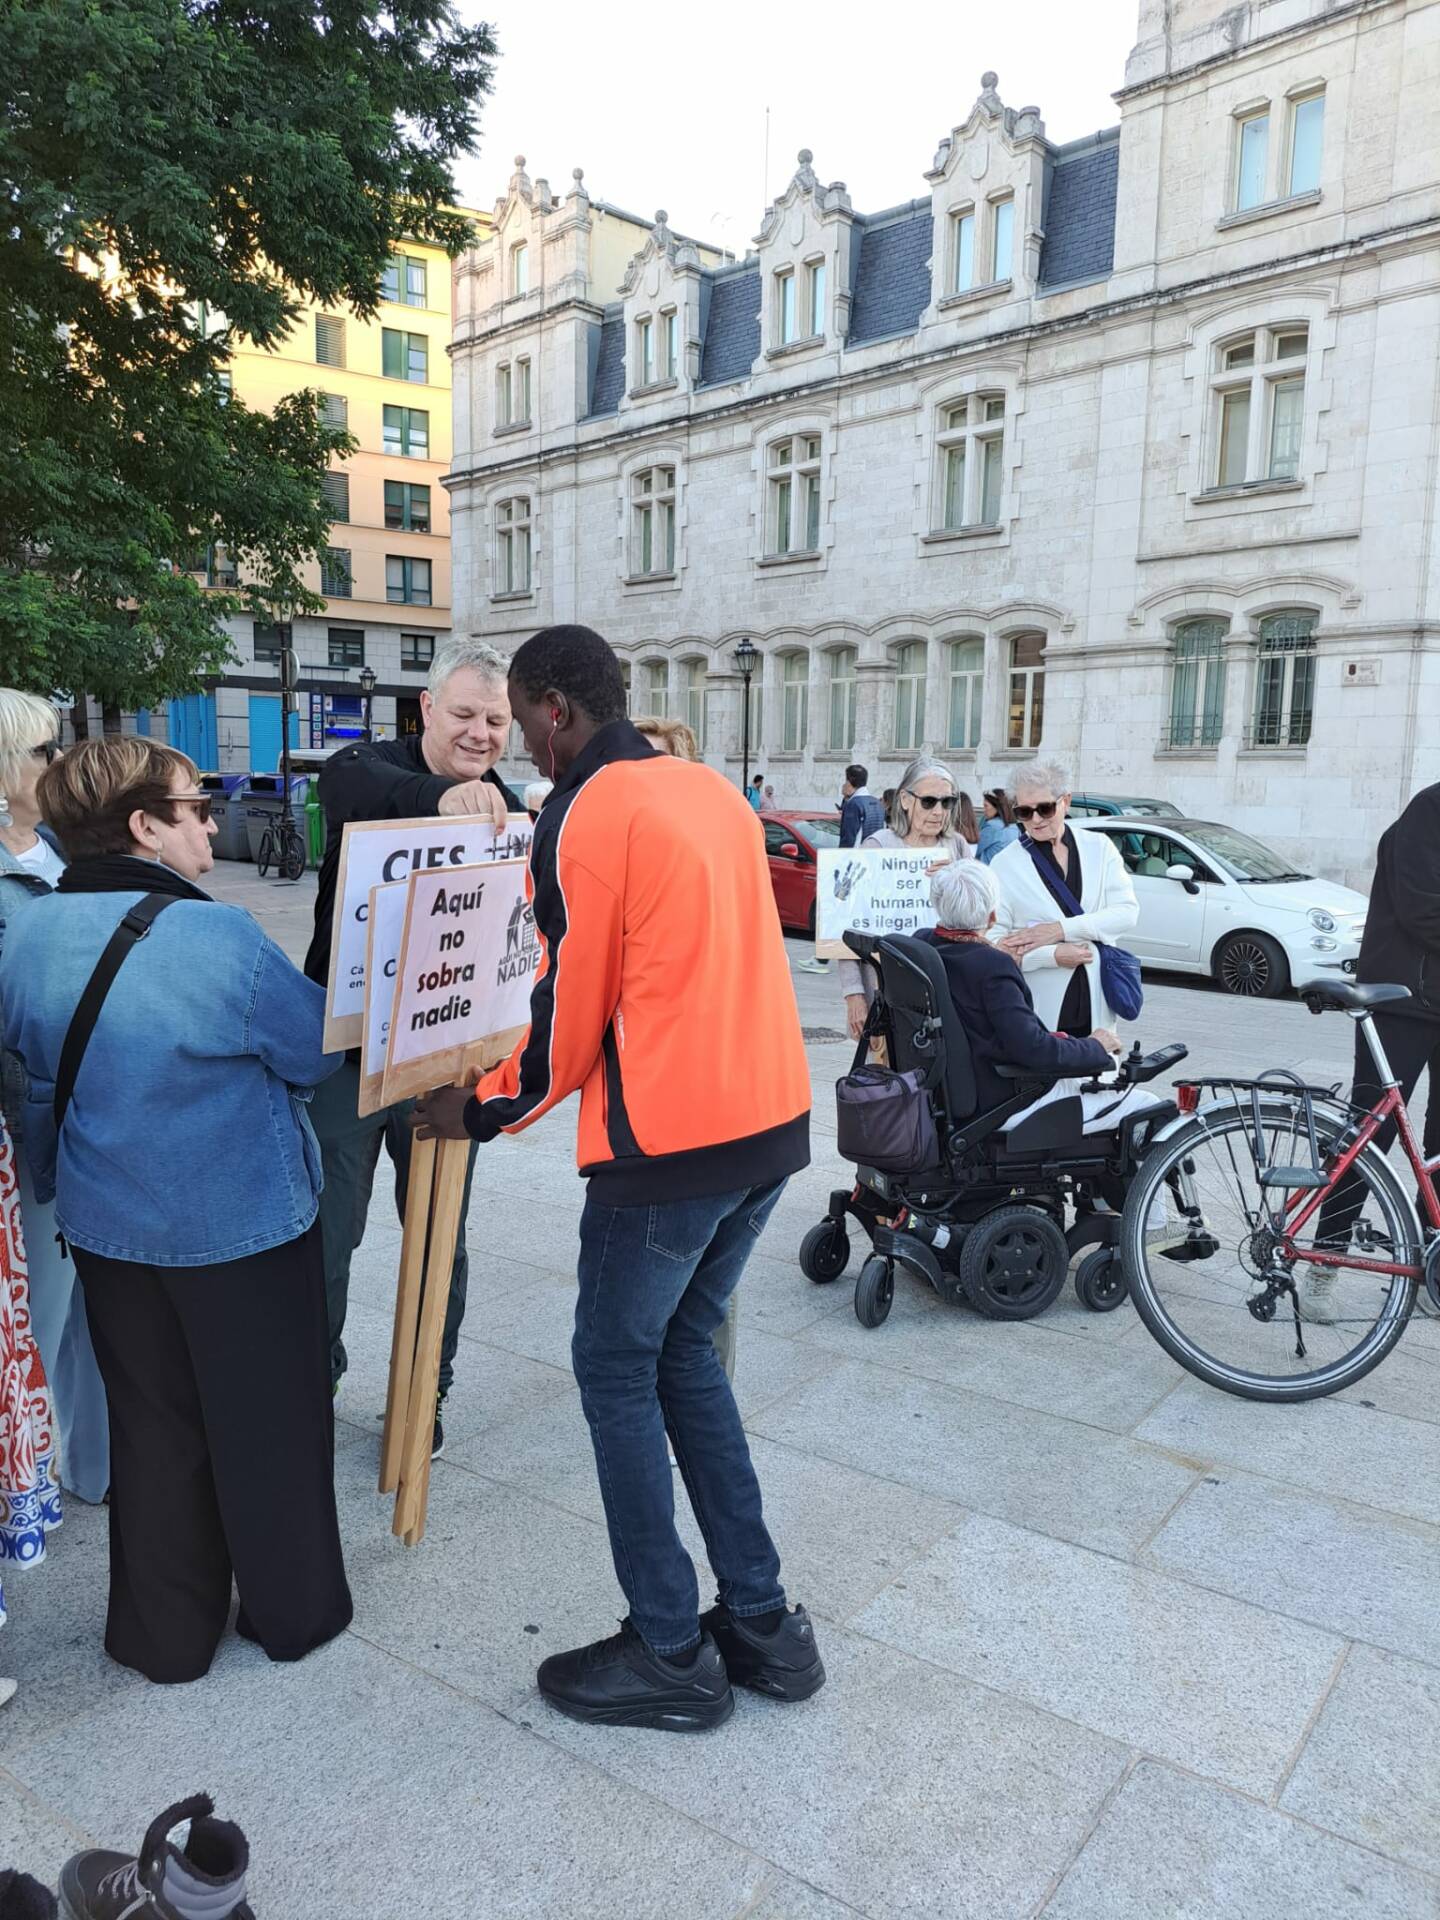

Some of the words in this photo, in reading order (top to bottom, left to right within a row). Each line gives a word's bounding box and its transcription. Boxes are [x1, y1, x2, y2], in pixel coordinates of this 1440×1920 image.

[404, 717, 417, 733] 14
[882, 856, 934, 873] Ningú
[896, 879, 922, 890] ser
[430, 882, 485, 917] Aquí
[852, 917, 870, 929] es
[876, 915, 918, 931] ilegal
[439, 929, 465, 952] no
[416, 961, 475, 993] sobra
[497, 949, 541, 987] NADIE
[411, 994, 472, 1031] nadie
